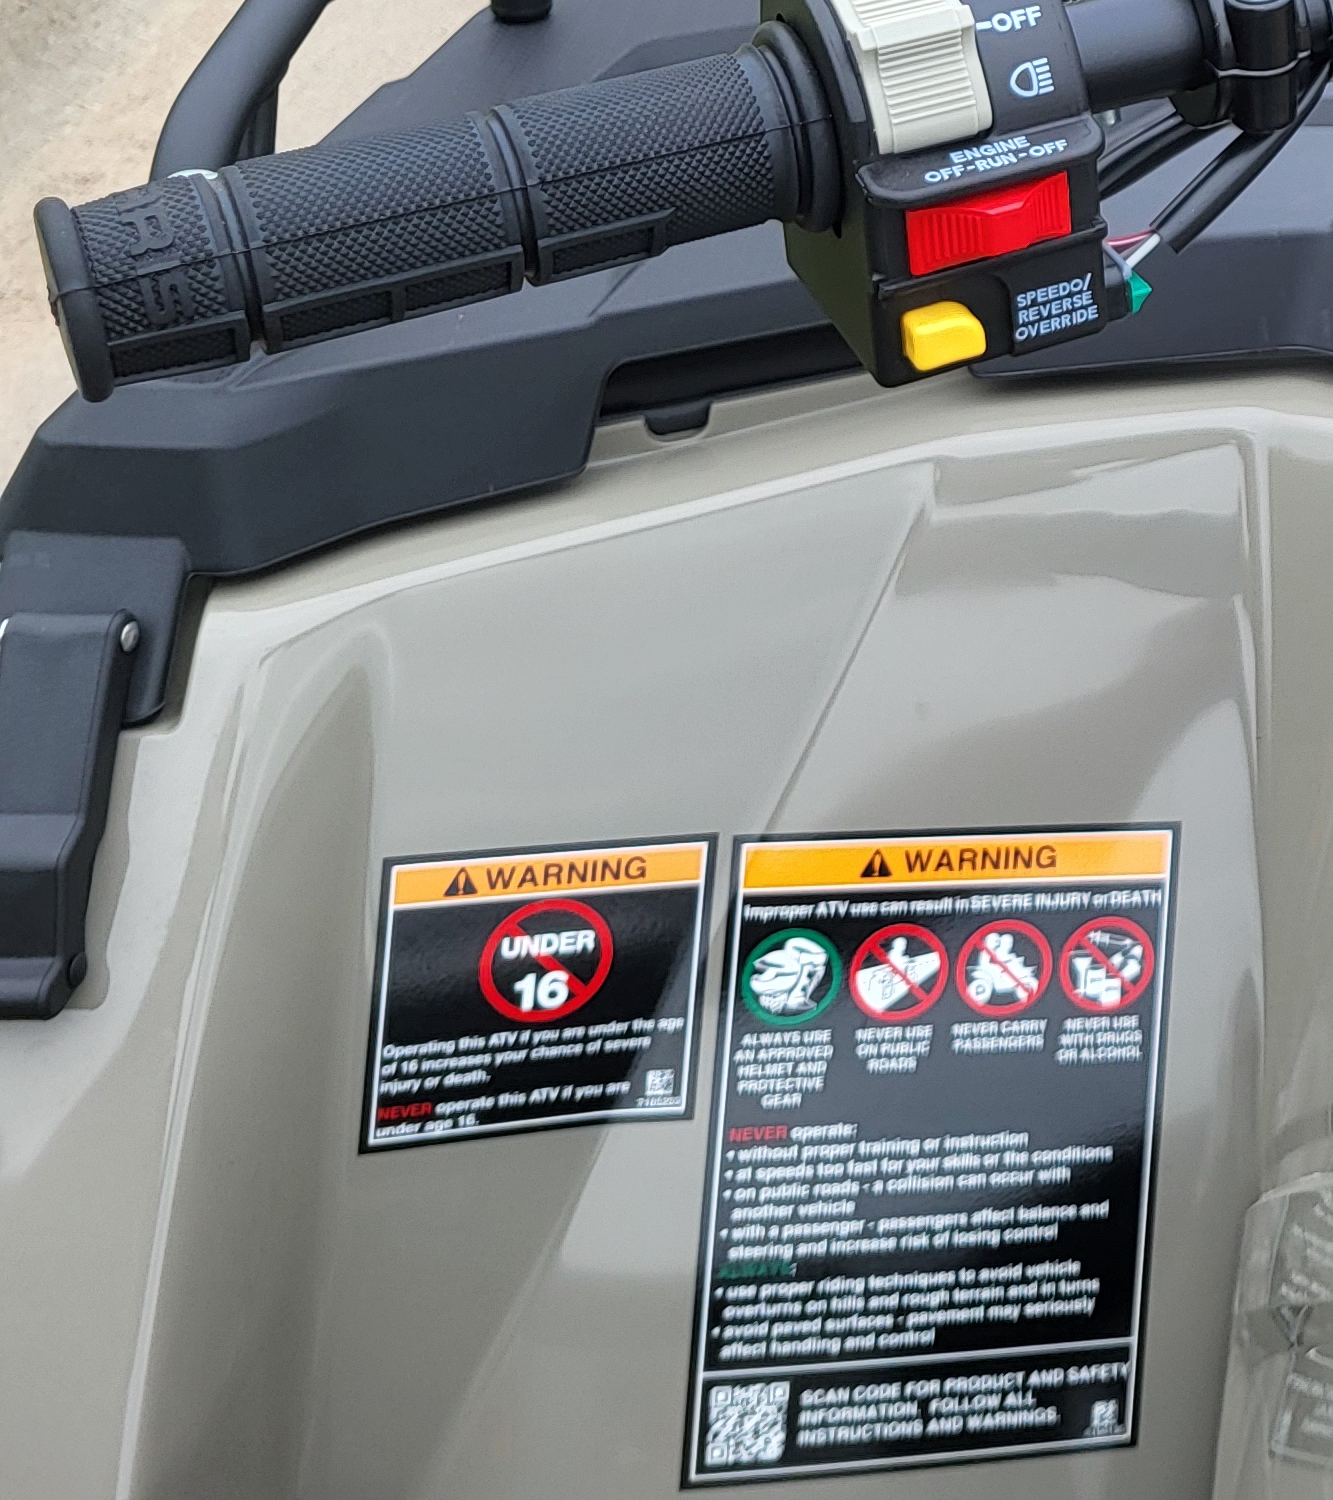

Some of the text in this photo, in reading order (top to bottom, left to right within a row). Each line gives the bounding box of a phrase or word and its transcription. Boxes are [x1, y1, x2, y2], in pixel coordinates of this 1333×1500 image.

[950, 135, 1030, 164] ENGINE
[1016, 273, 1093, 307] SPEEDO/
[1015, 304, 1099, 341] OVERRIDE
[1018, 291, 1094, 324] REVERSE
[485, 855, 648, 891] WARNING
[903, 845, 1058, 873] WARNING
[500, 928, 596, 959] UNDER
[511, 970, 570, 1012] 16
[382, 1017, 683, 1061] Operating this ATV if you are under the age
[381, 1037, 651, 1076] of 16 increases your chance of severe
[377, 1082, 630, 1120] NEVER operate this ATV if you are
[379, 1076, 421, 1096] injury
[423, 1076, 441, 1089] or
[376, 1120, 421, 1136] under
[423, 1119, 453, 1132] age
[729, 1125, 787, 1141] NEVER
[737, 1130, 1029, 1163] without proper training or instruction
[801, 1361, 1129, 1408] SCAN CODE FOR PRODUCT AND SAFETY
[928, 1392, 1001, 1416] FOLLOW
[1004, 1389, 1037, 1409] ALL
[797, 1418, 923, 1447] INSTRUCTIONS
[925, 1415, 963, 1436] AND
